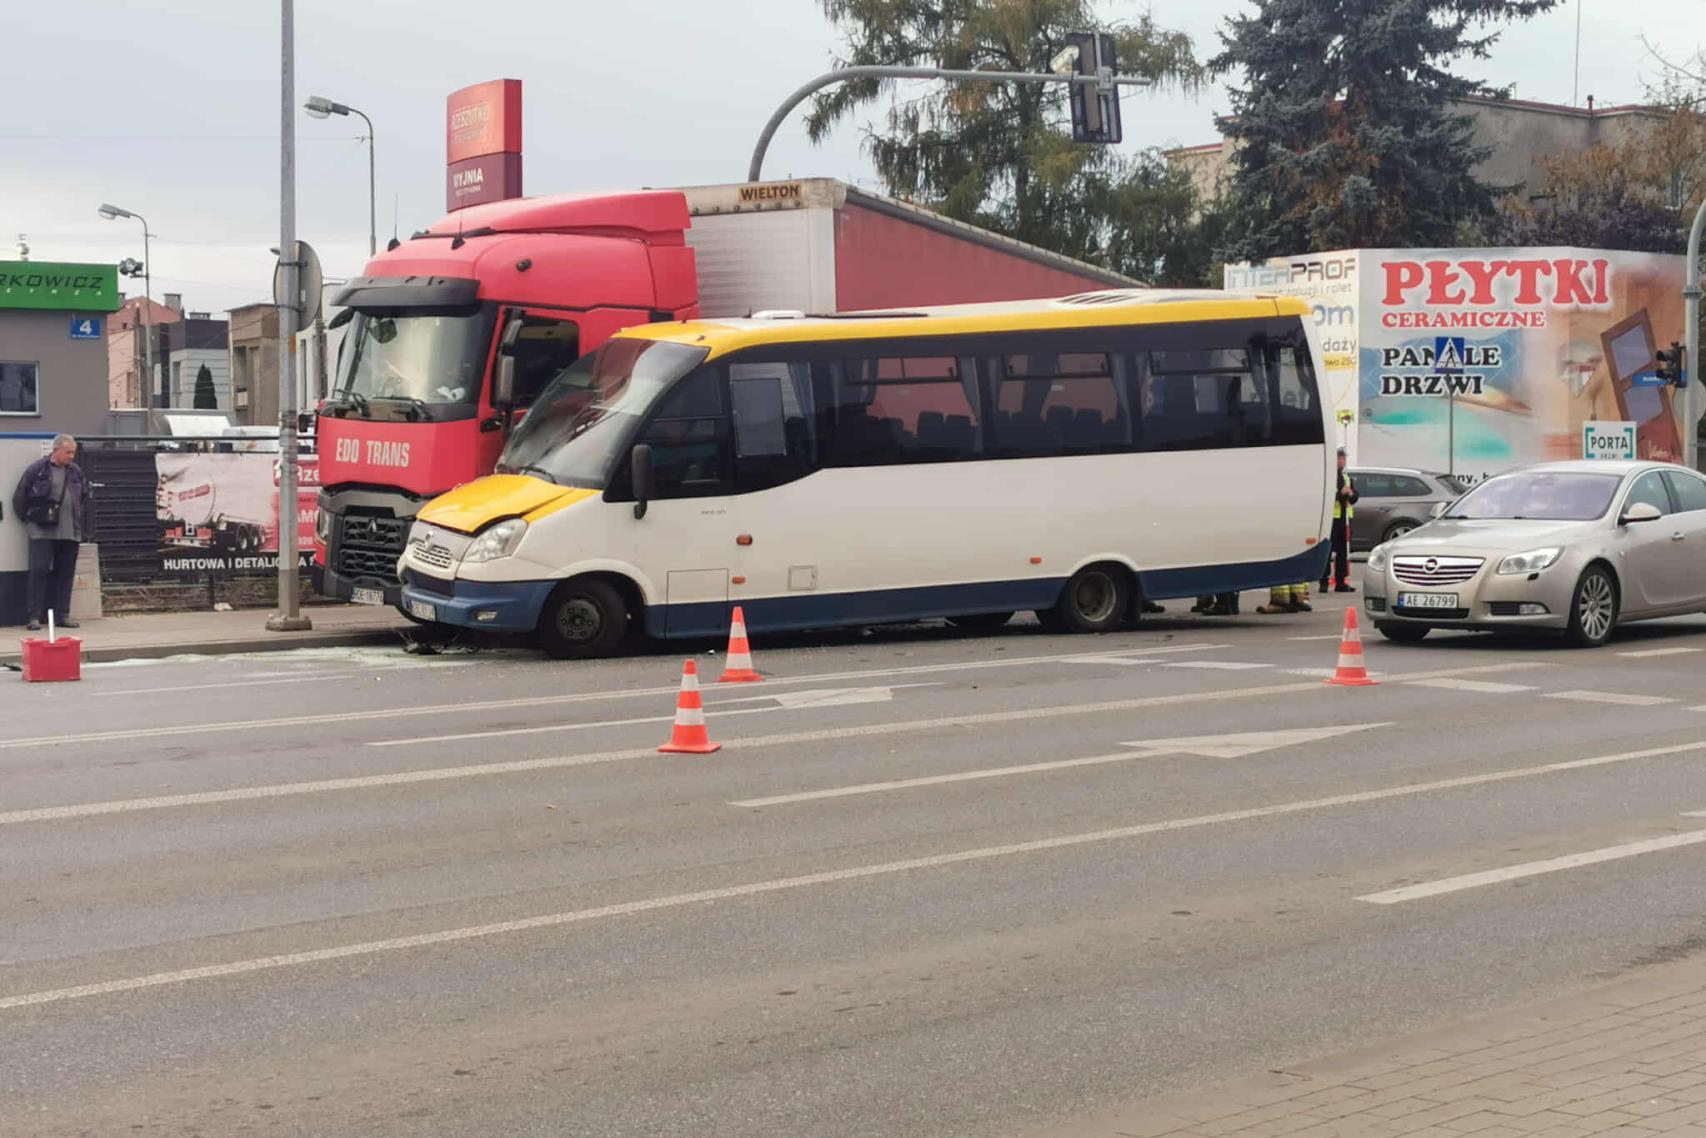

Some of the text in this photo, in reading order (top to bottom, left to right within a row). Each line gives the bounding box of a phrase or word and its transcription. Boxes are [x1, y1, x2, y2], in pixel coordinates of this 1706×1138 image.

[741, 184, 801, 201] WIELTON
[1381, 259, 1609, 306] PŁYTKI
[79, 320, 92, 334] 4
[1381, 311, 1545, 328] CERAMICZNE
[1382, 376, 1483, 395] DRZWI
[1590, 436, 1629, 449] PORTA
[336, 437, 411, 468] EDO TRANS
[164, 557, 226, 570] HURTOWA
[1406, 595, 1456, 607] AE 26799
